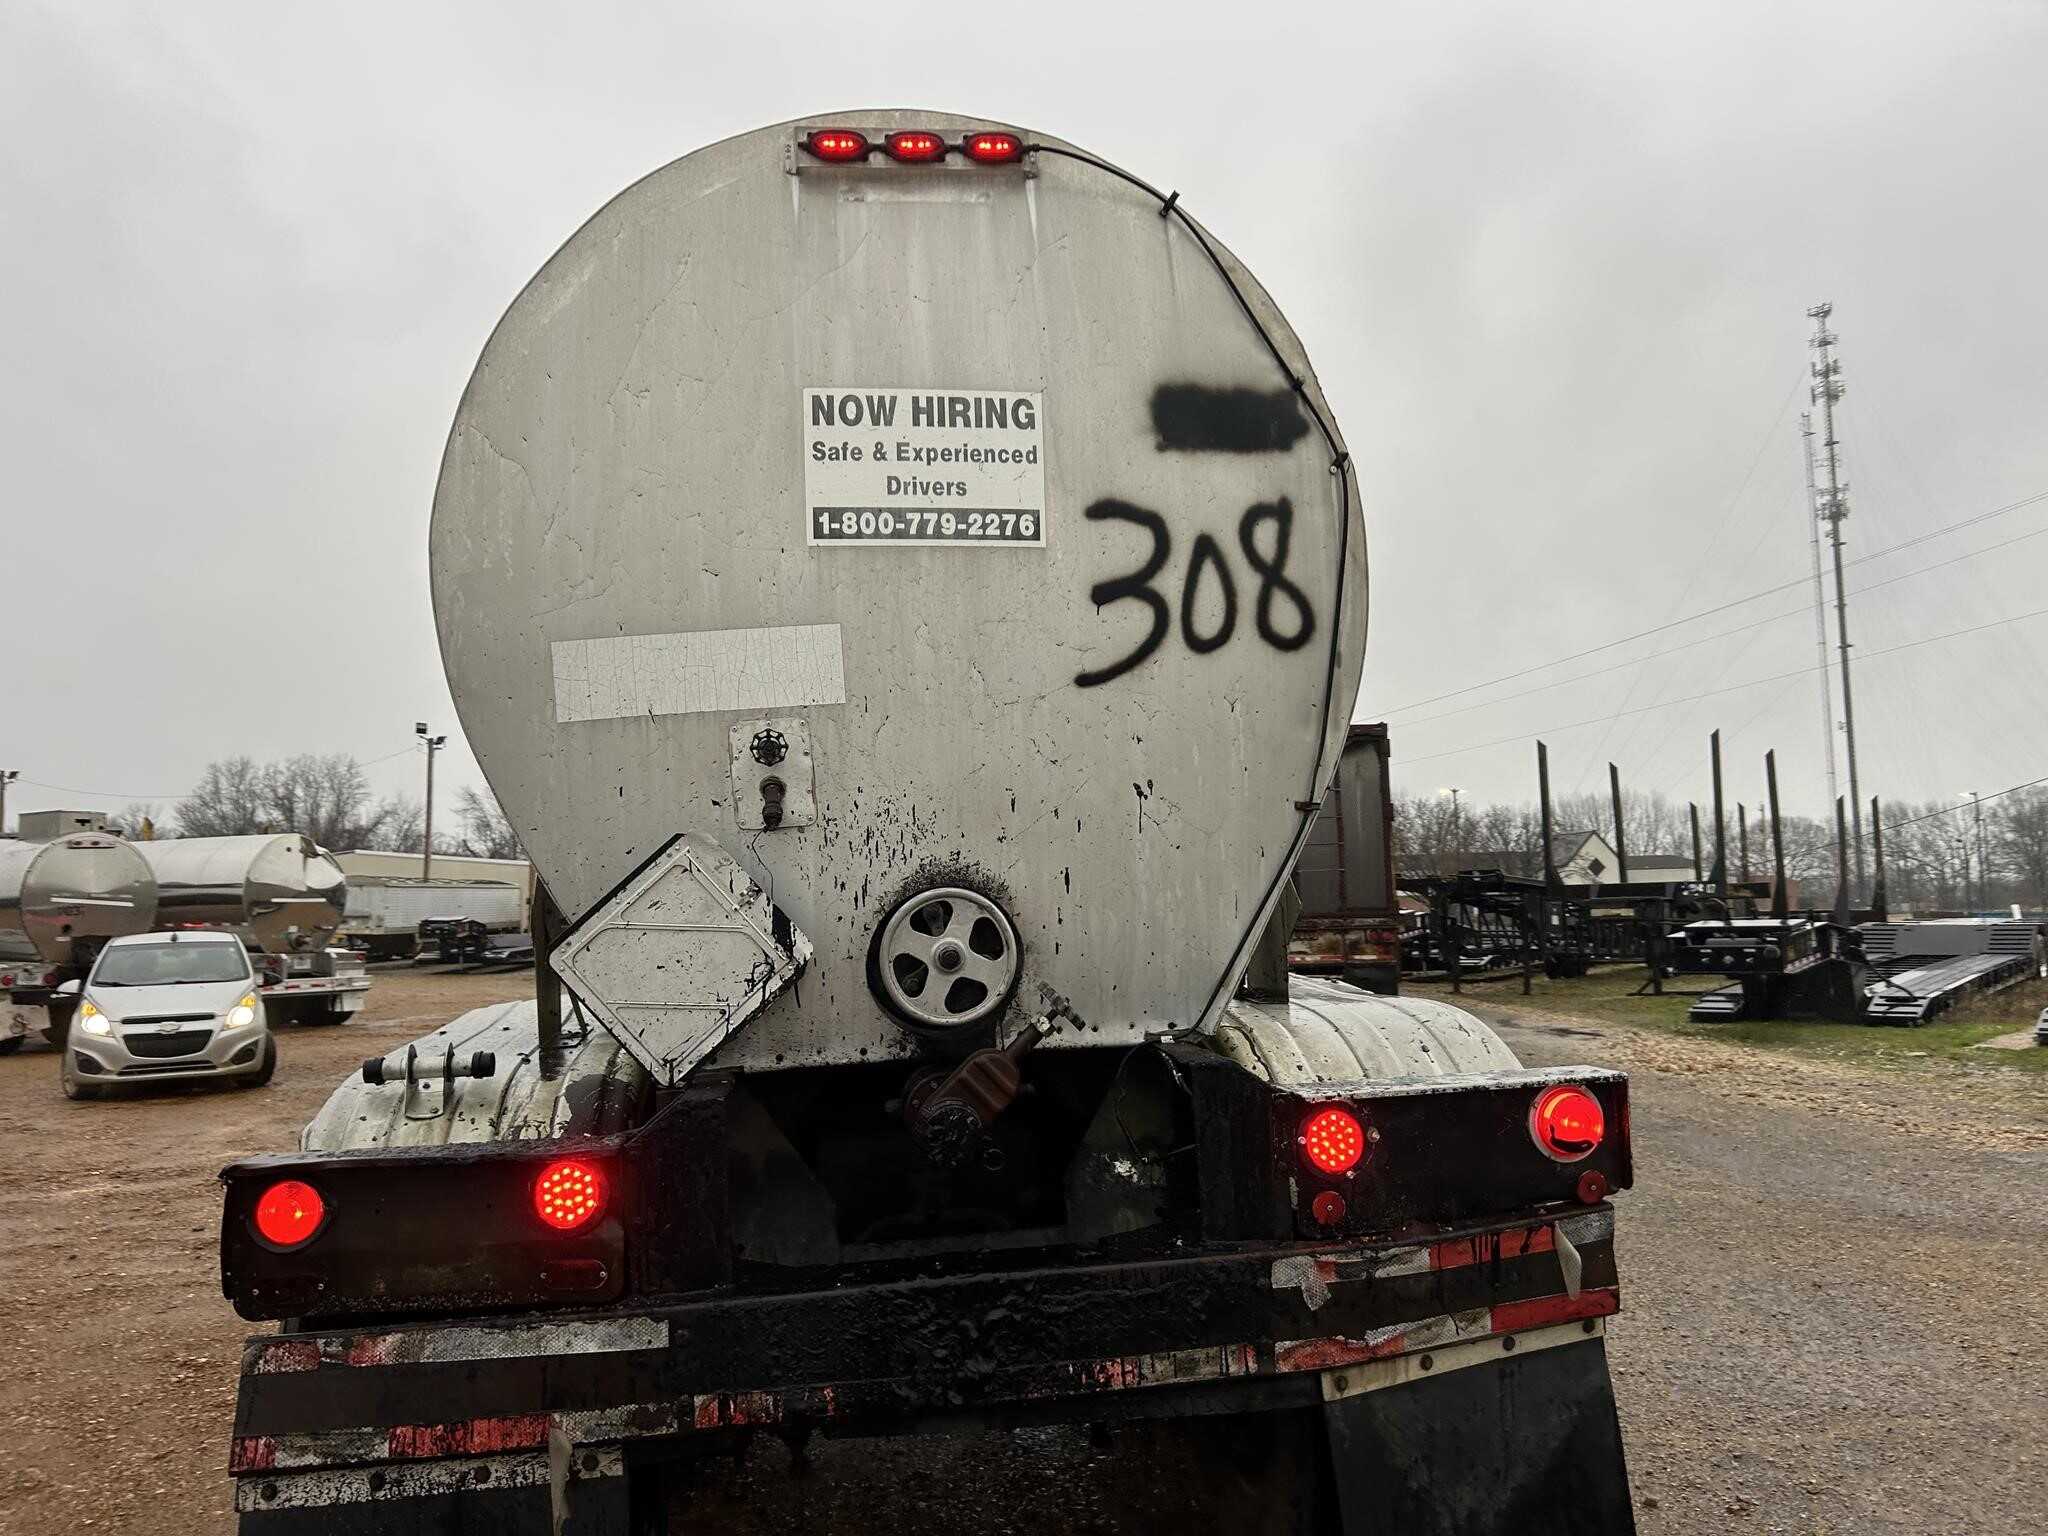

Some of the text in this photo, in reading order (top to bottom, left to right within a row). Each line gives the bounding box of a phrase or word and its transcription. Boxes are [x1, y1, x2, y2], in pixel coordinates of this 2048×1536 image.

[811, 394, 1036, 430] NOW HIRING
[812, 441, 1038, 465] Safe & Experienced
[886, 475, 967, 497] Drivers
[818, 512, 1035, 536] 1-800-779-2276
[1073, 495, 1316, 688] 308
